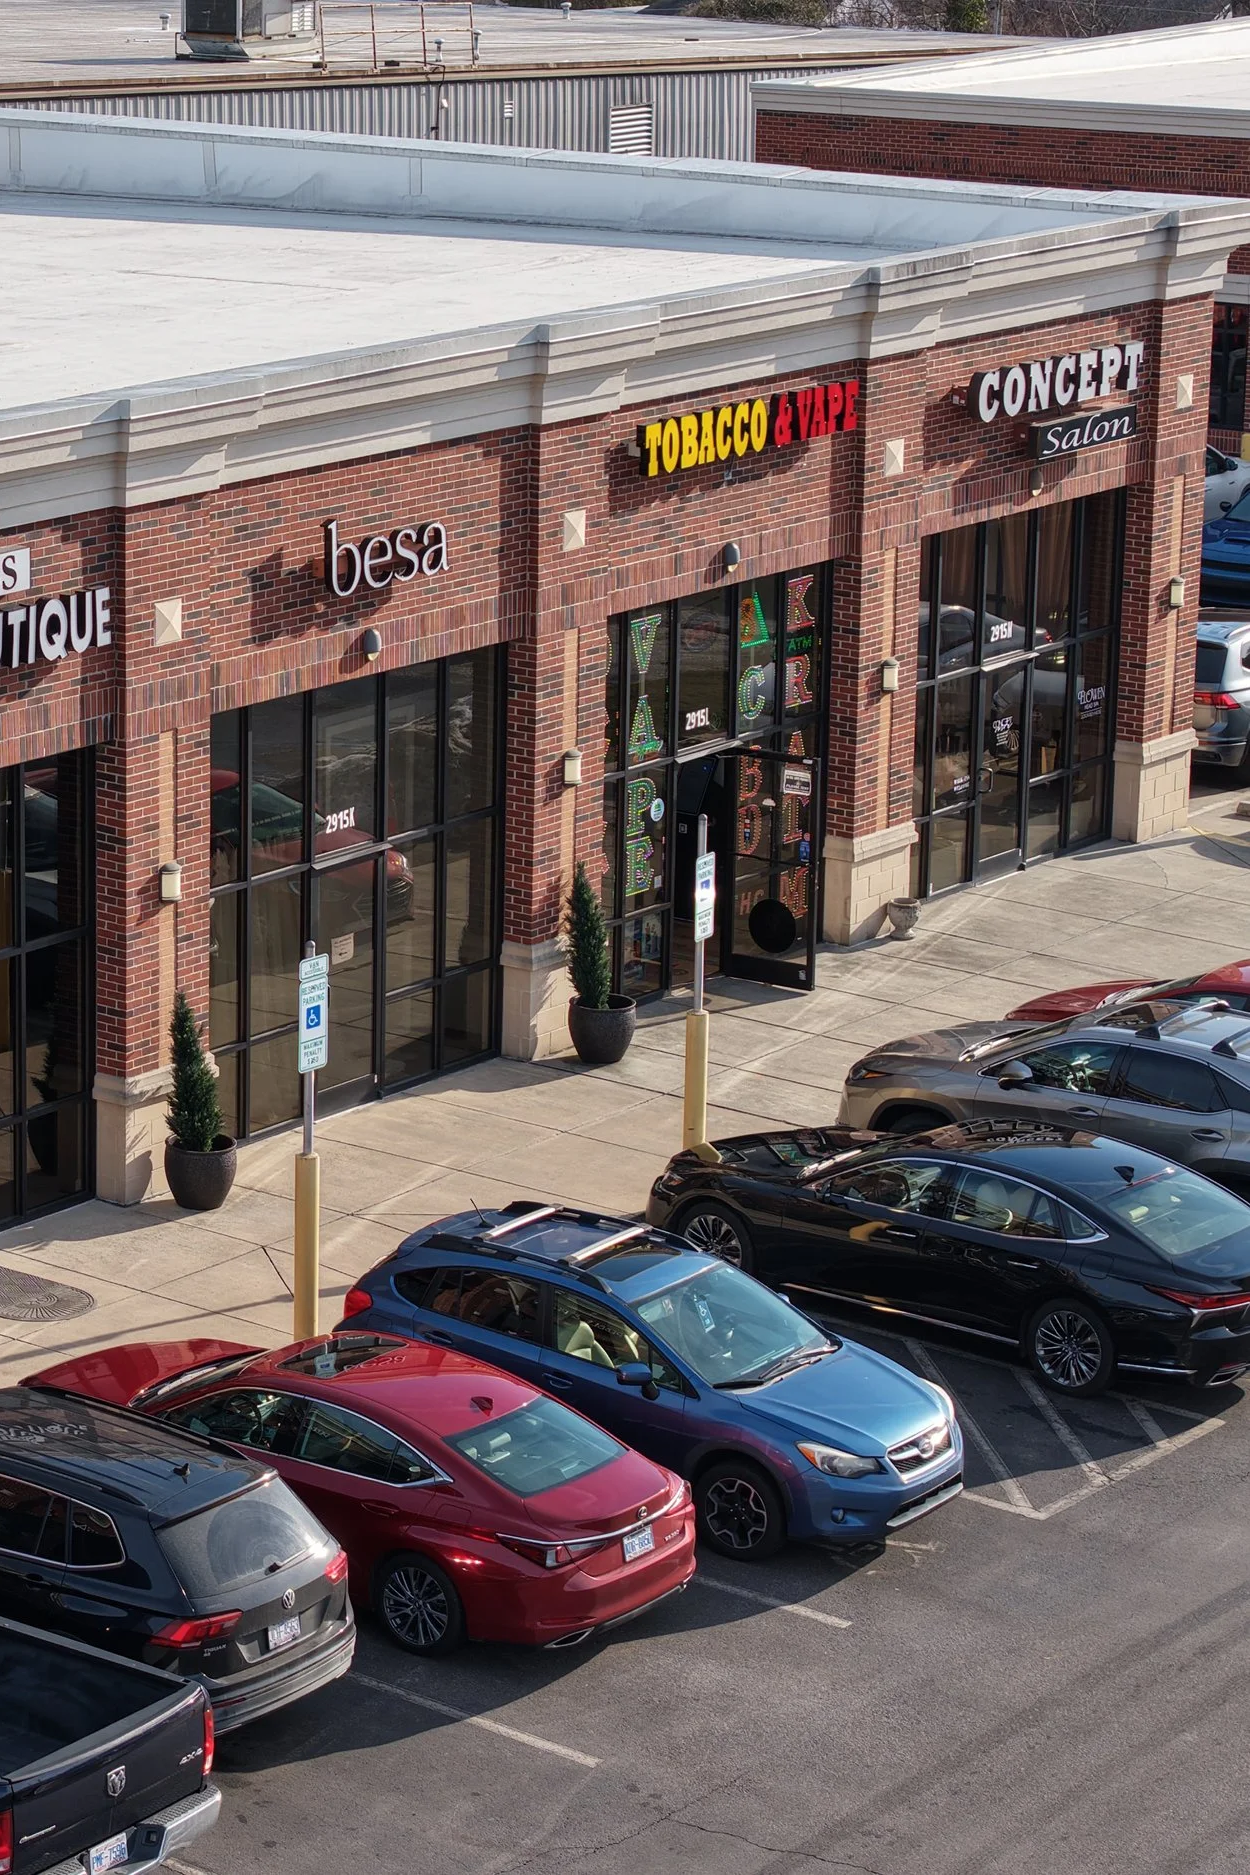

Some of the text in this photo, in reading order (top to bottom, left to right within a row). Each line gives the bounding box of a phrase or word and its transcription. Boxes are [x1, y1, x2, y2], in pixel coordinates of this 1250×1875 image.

[977, 341, 1144, 424] CONCEPT
[644, 379, 860, 477] TOBACCO & VAPE
[1042, 414, 1133, 454] Salon
[327, 520, 450, 597] besa
[685, 707, 710, 731] 2915L
[325, 806, 355, 834] 2915K
[308, 961, 320, 969] VAN
[301, 981, 327, 996] RESERVED
[302, 992, 325, 1006] PARKING
[303, 1047, 323, 1059] PENALTY
